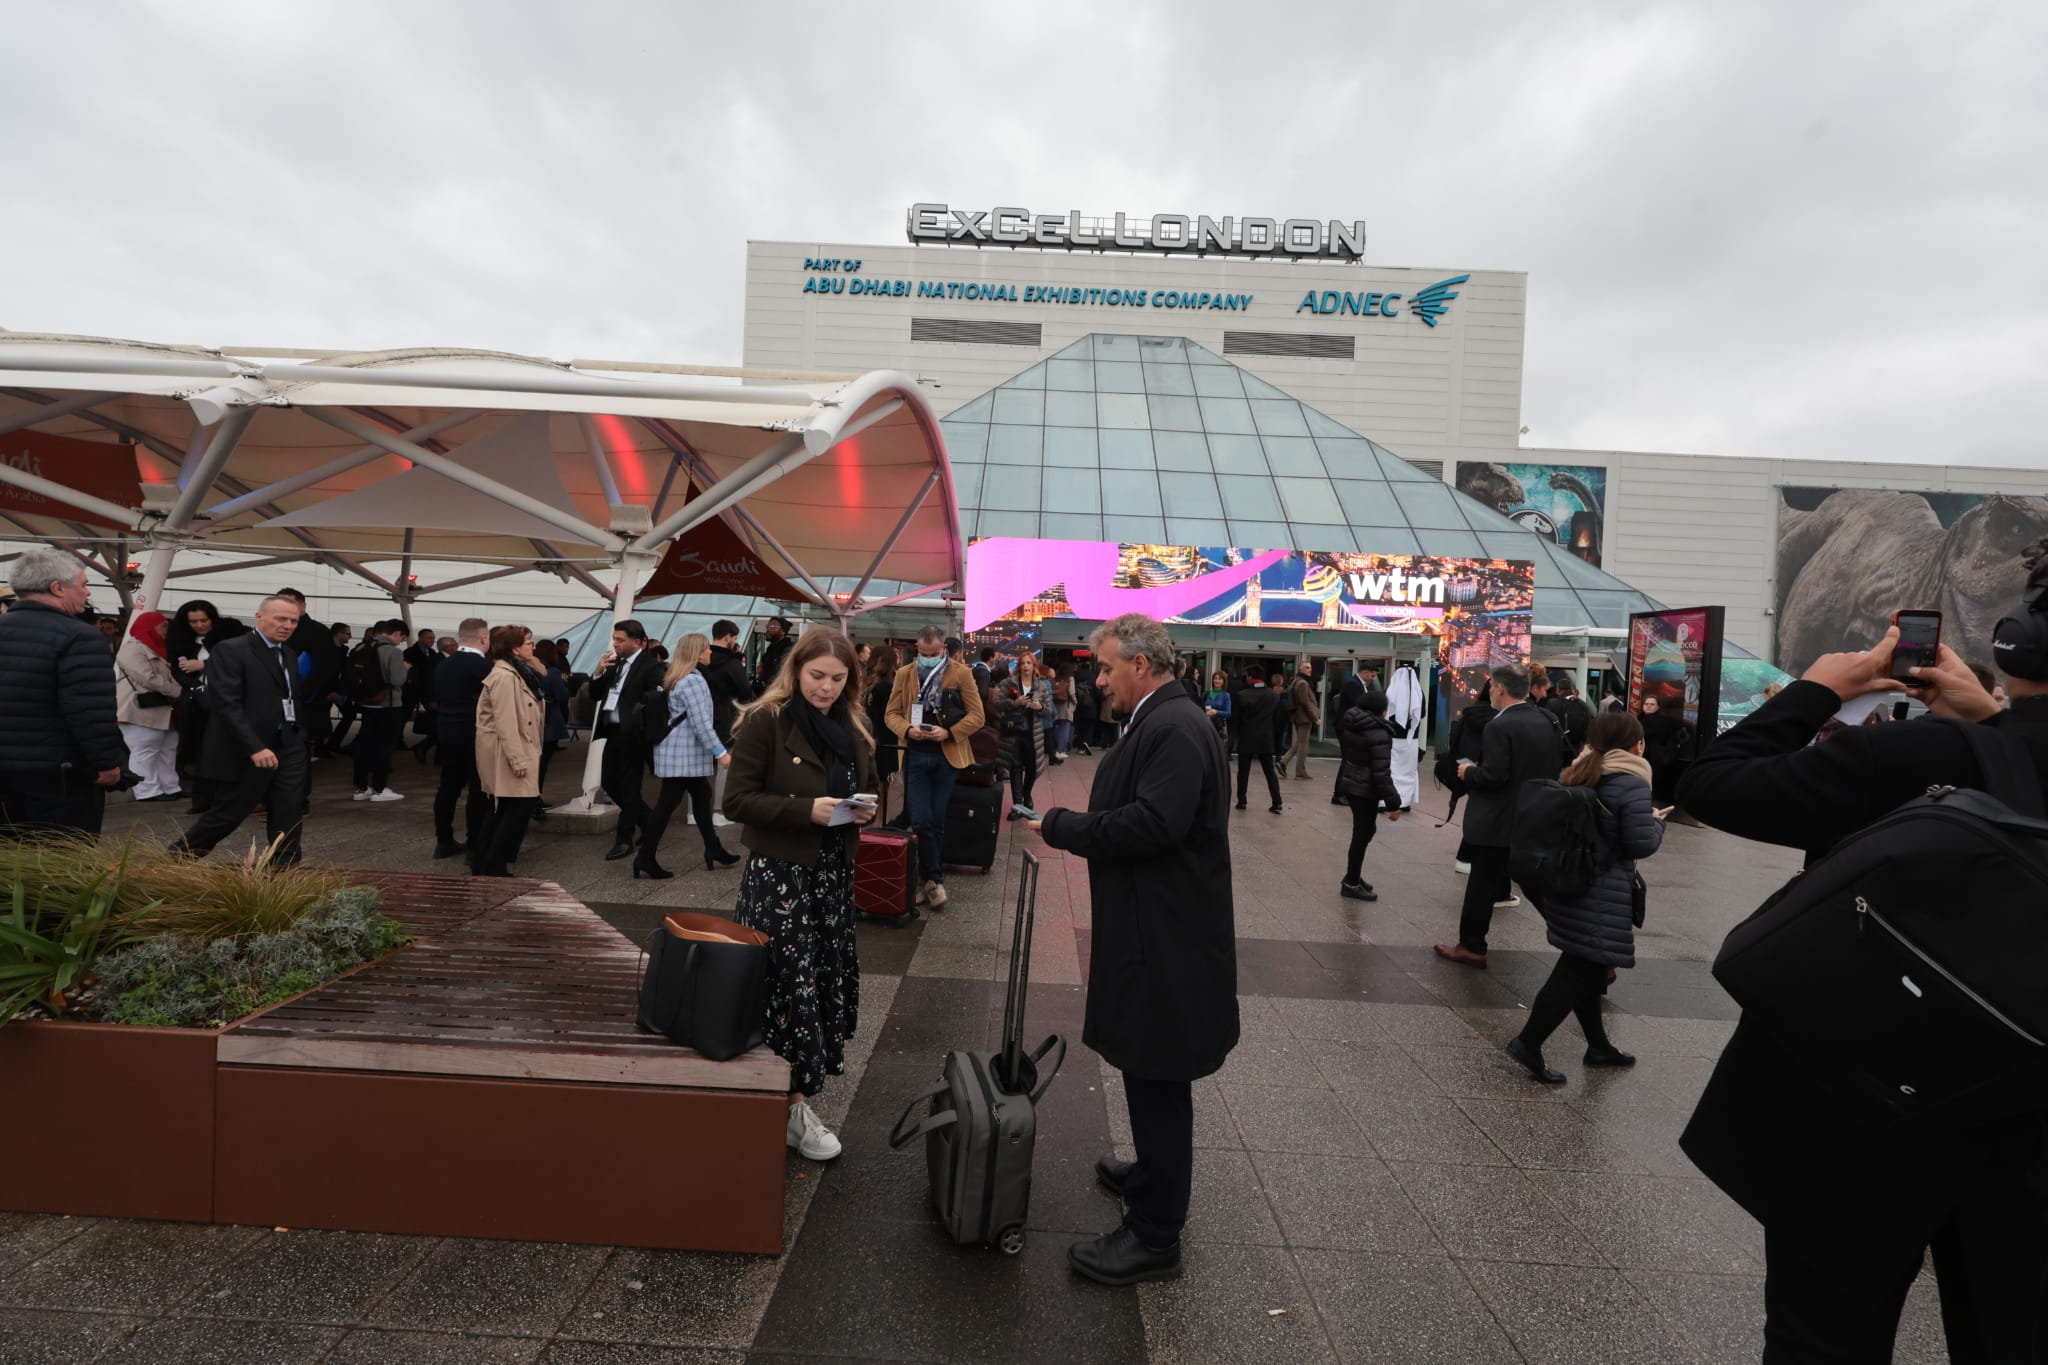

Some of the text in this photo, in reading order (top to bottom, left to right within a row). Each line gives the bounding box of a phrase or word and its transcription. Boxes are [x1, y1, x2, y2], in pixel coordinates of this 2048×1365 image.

[1115, 211, 1365, 255] LONDON
[803, 258, 861, 272] PART OF
[803, 277, 1254, 311] ABU DHABI NATIONAL EXHIBITIONS COMPANY
[1296, 290, 1402, 317] ADNEC
[670, 551, 761, 578] Saudi
[1349, 567, 1445, 604] wtm
[1375, 607, 1417, 617] LONDON
